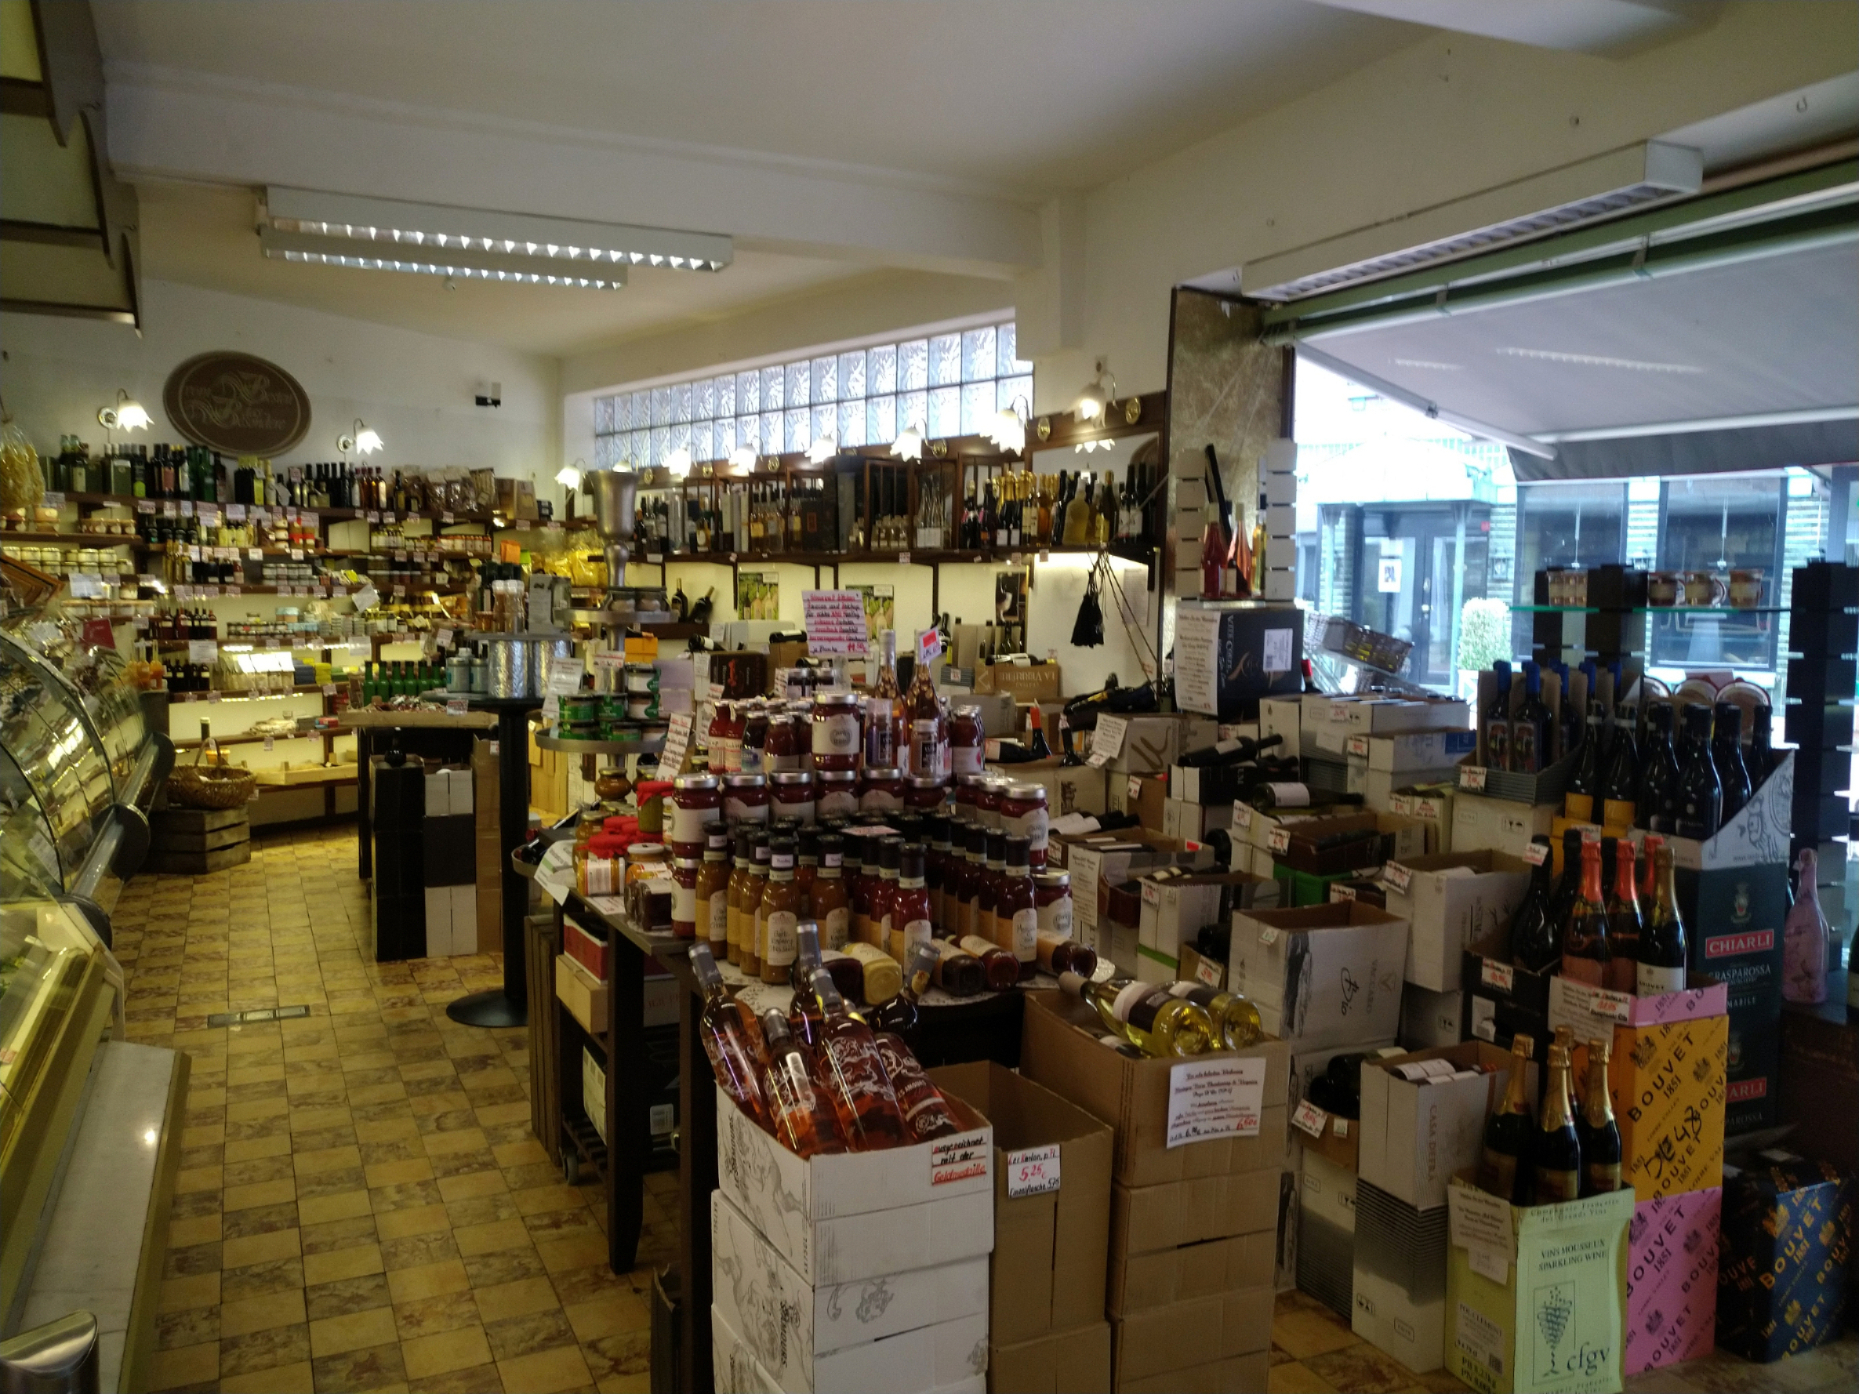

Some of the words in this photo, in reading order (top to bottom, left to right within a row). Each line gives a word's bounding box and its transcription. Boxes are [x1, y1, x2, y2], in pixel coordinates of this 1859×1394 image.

[1709, 934, 1772, 954] CHIARLI
[1727, 996, 1756, 1009] MABILE
[1627, 1031, 1694, 1122] BOUVET
[1663, 1075, 1681, 1099] 1851
[1729, 1082, 1763, 1099] ARLI
[1429, 1105, 1438, 1137] CASA
[940, 1151, 956, 1165] mit
[959, 1150, 975, 1162] der
[1541, 1246, 1560, 1259] VINS
[1561, 1238, 1606, 1255] MOUSSEUX
[1627, 1204, 1685, 1298] BOUVET
[1759, 1196, 1822, 1290] BOUVET
[1538, 1254, 1583, 1272] SPARKLING
[1585, 1250, 1607, 1262] WINE
[1654, 1248, 1672, 1273] 1851
[1566, 1341, 1611, 1377] cfgv
